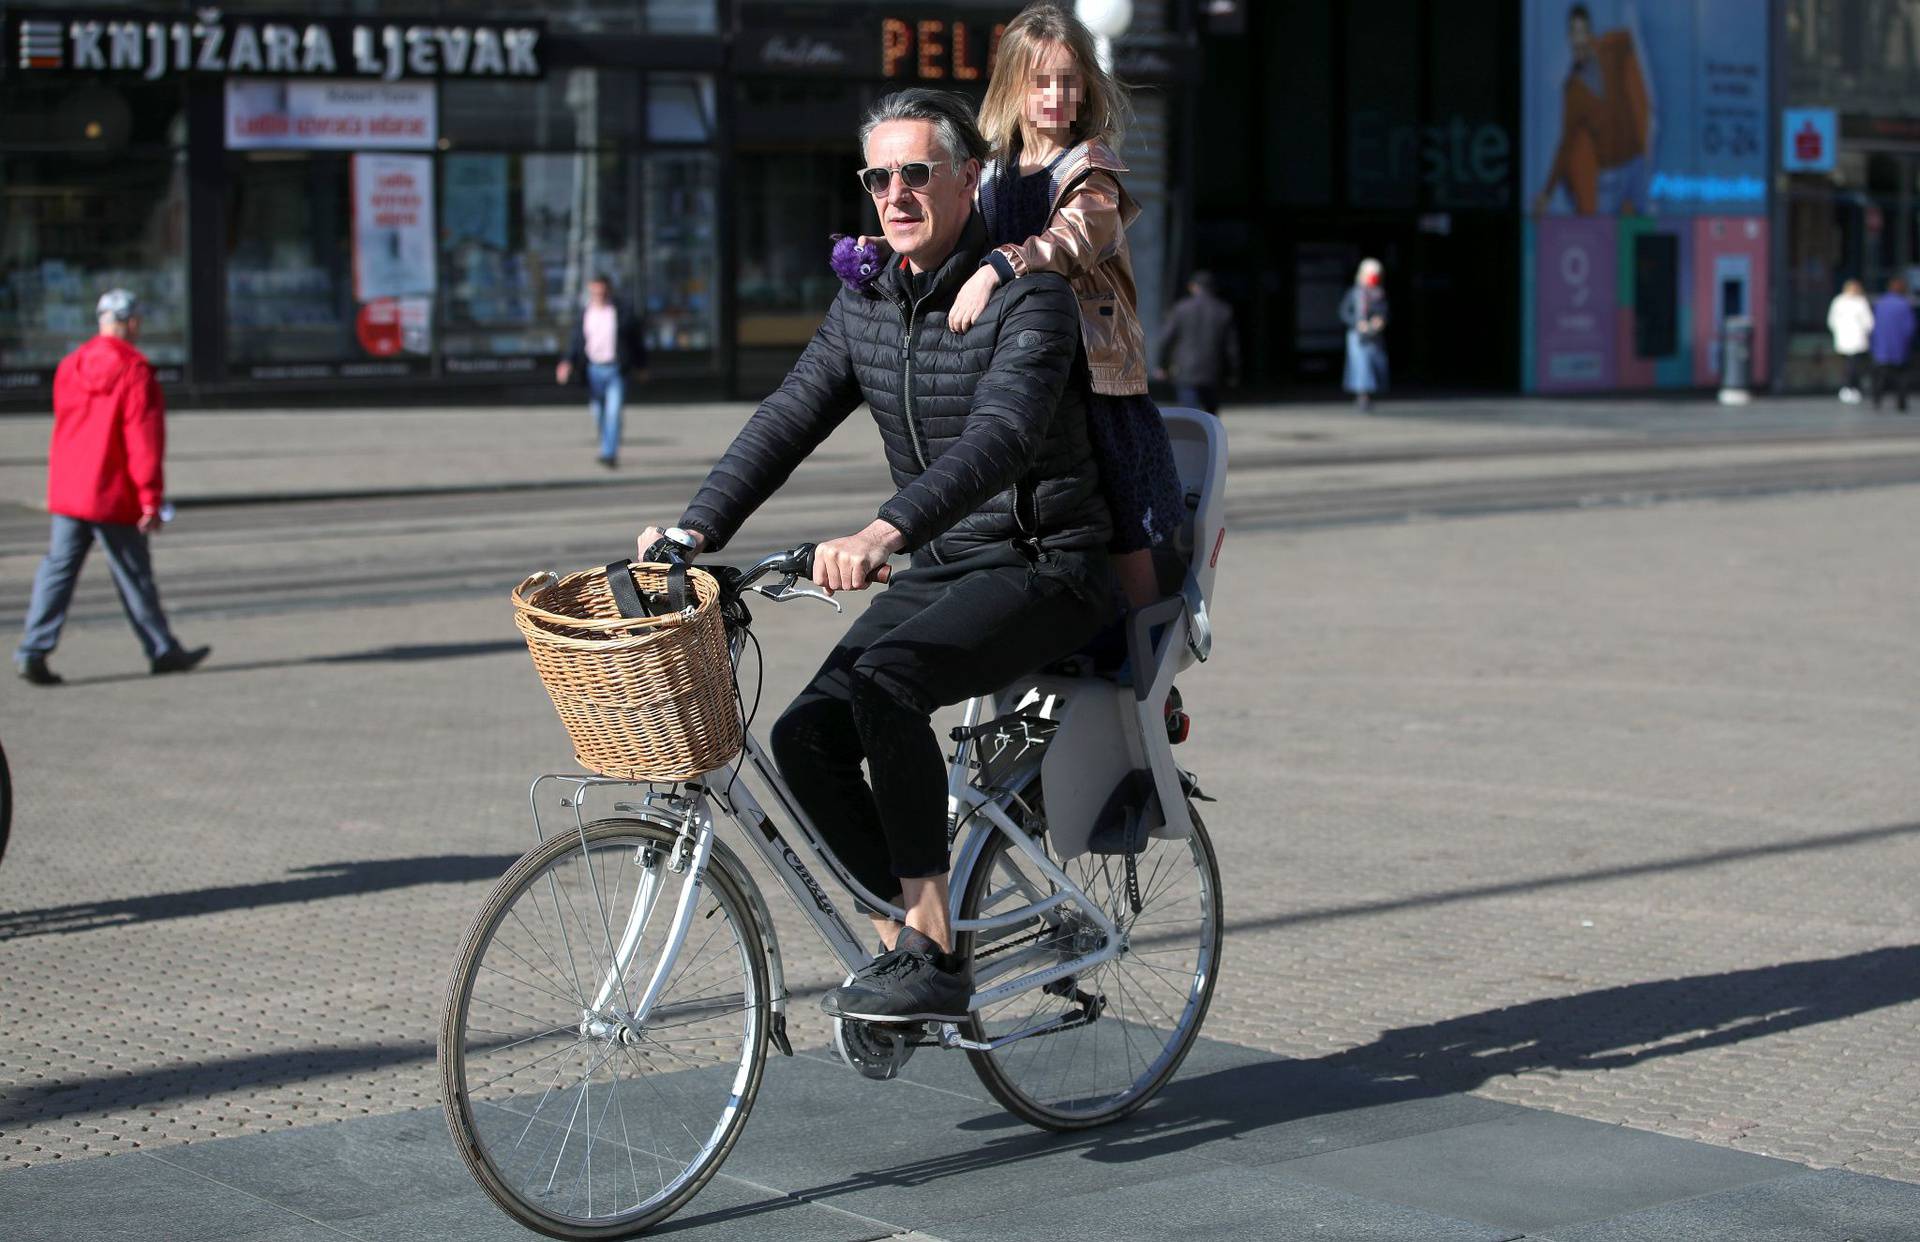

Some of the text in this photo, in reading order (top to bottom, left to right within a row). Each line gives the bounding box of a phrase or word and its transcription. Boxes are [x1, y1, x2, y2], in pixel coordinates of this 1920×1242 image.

[70, 7, 540, 81] KNJIŽARA LJEVAK
[1350, 111, 1509, 184] Erste
